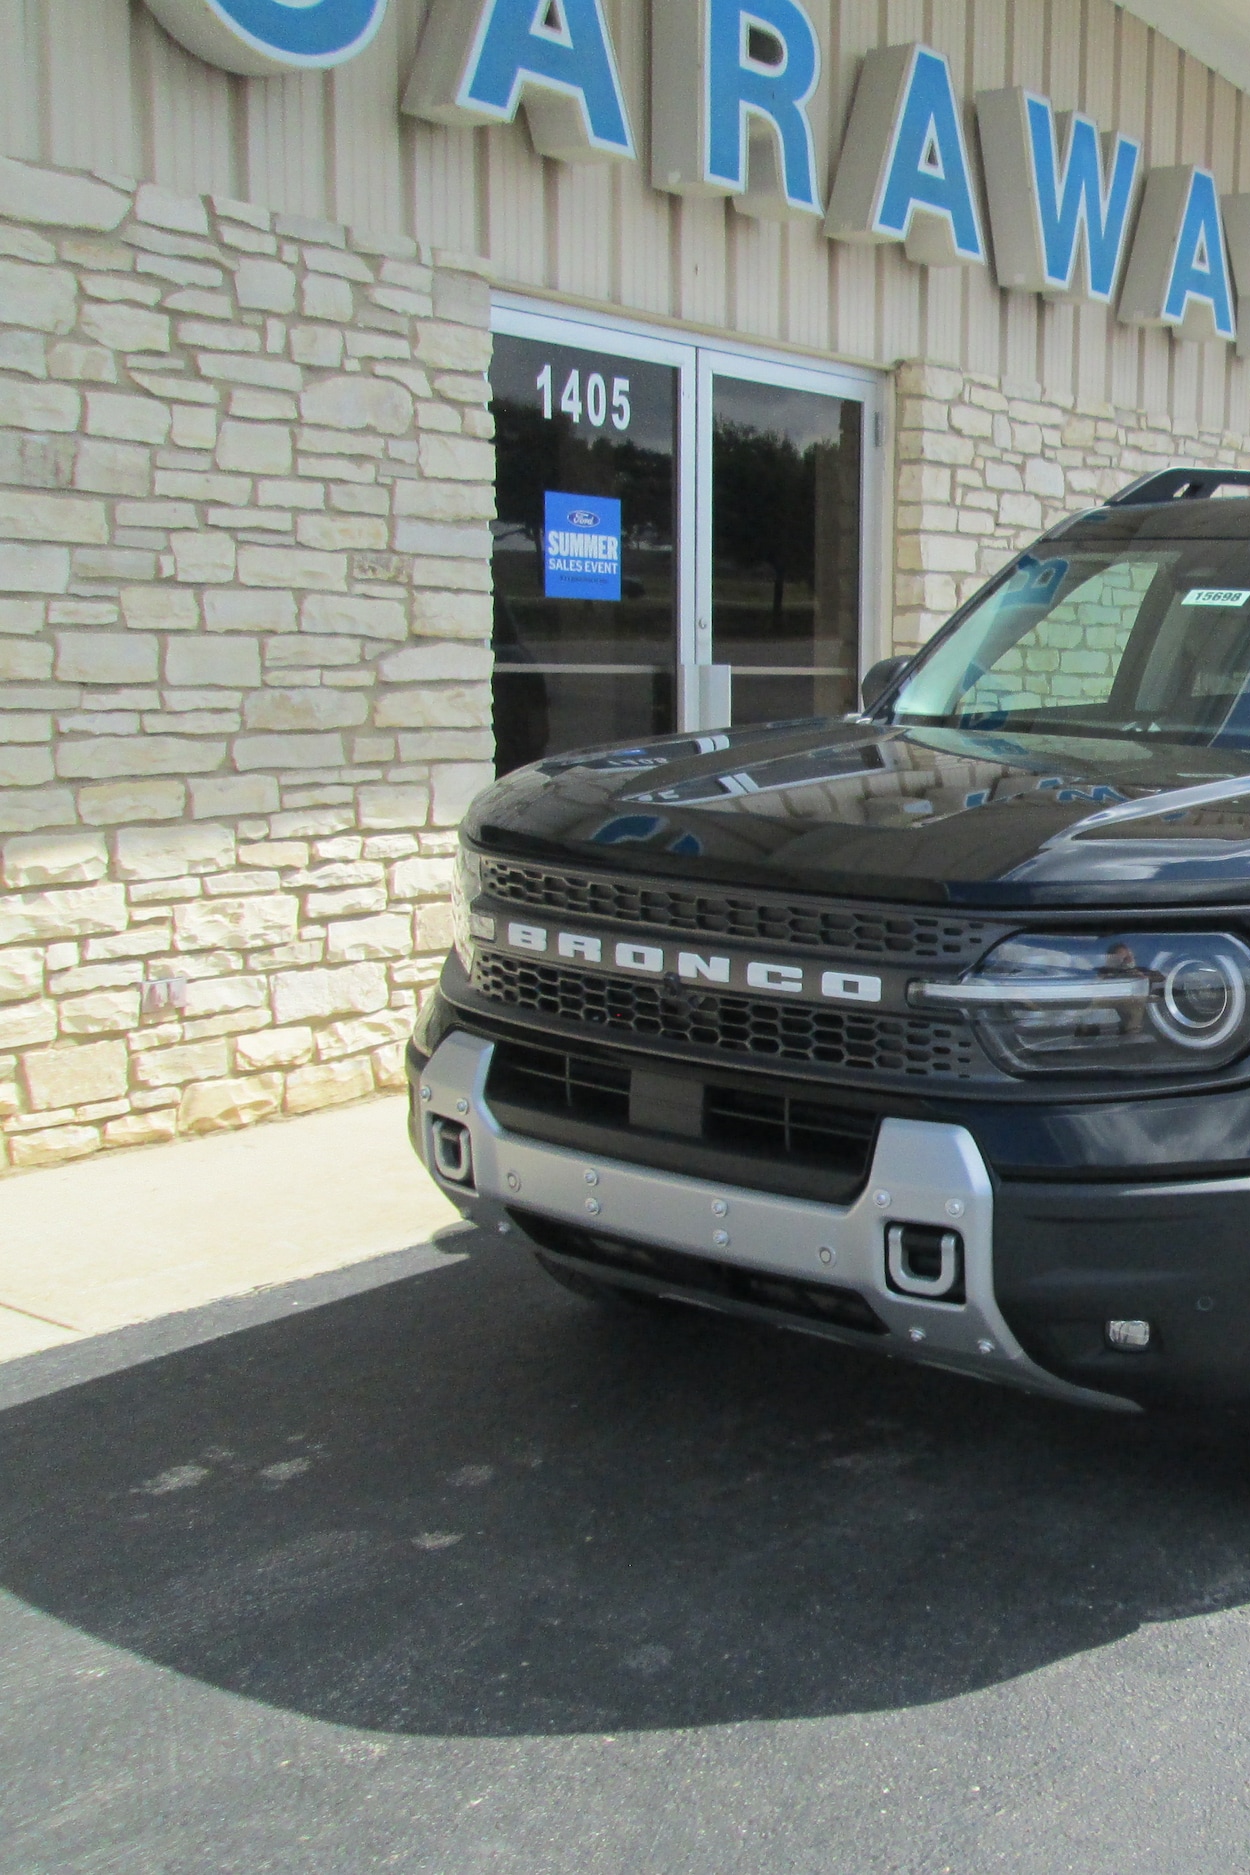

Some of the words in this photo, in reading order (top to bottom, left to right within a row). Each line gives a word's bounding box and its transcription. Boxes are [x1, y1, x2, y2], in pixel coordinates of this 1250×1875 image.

[537, 364, 631, 431] 1405
[573, 511, 595, 526] Ford
[548, 530, 618, 560] SUMMER
[549, 558, 582, 573] SALES
[584, 561, 618, 574] EVENT
[1195, 591, 1242, 602] 15698
[508, 922, 882, 1002] BRONCO
